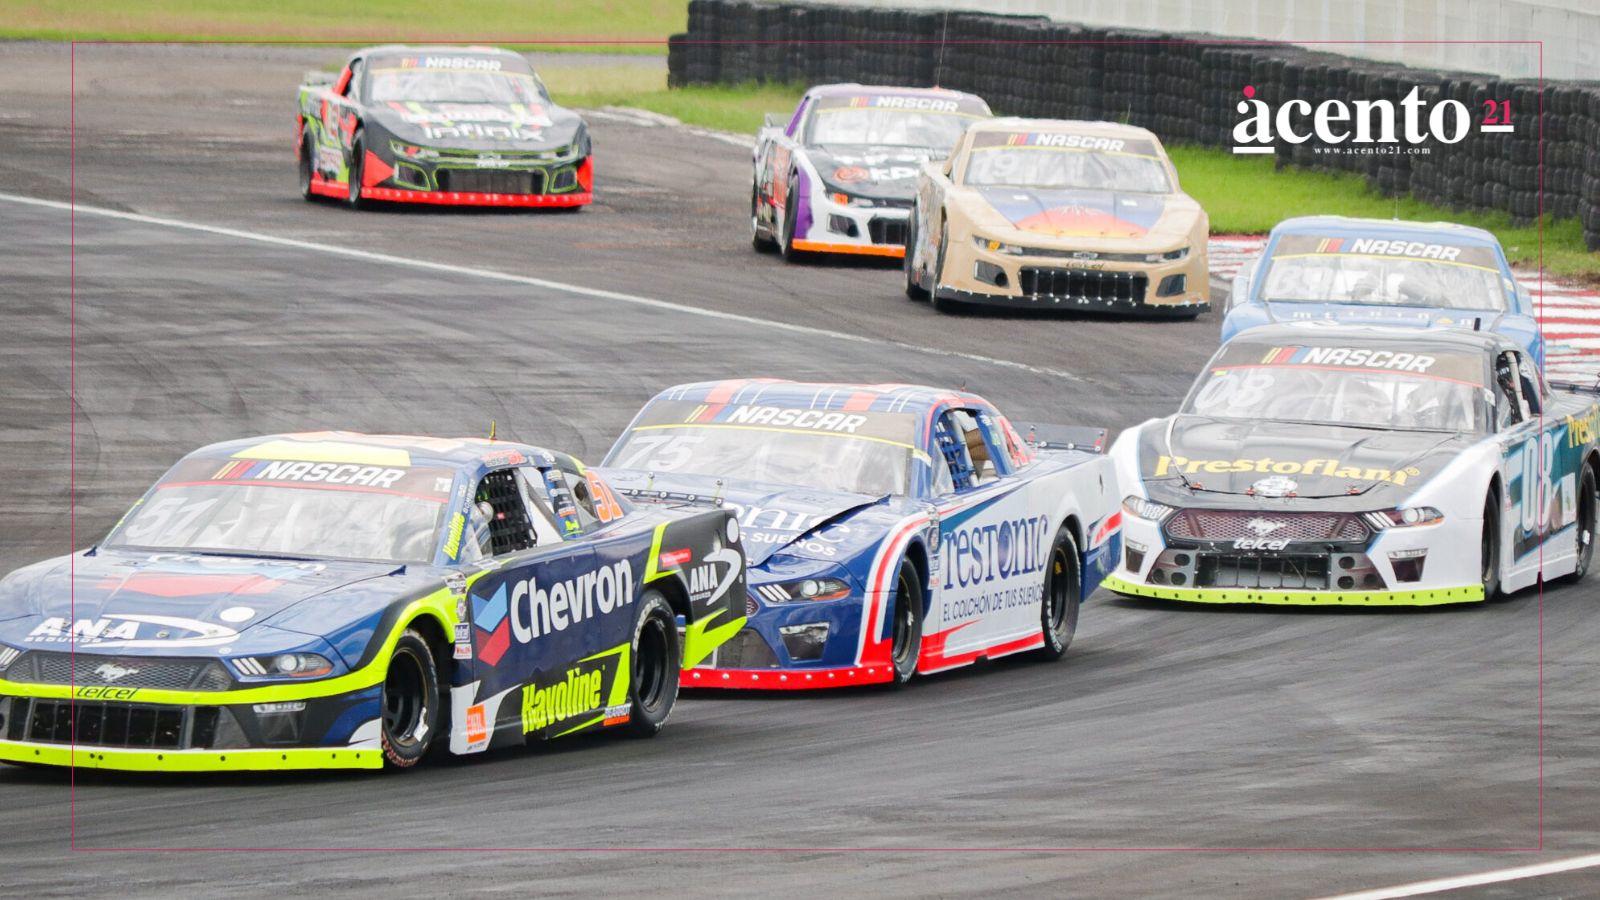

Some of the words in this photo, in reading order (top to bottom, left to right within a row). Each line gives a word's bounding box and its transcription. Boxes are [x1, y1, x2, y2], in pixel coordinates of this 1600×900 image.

[426, 57, 501, 71] NASCAR
[876, 96, 959, 112] NASCAR
[1036, 133, 1125, 151] NASCAR
[1351, 238, 1461, 261] NASCAR
[1301, 346, 1436, 372] NASCAR
[725, 405, 867, 433] NASCAR
[621, 435, 704, 471] 75
[254, 461, 405, 489] NASCAR
[1521, 429, 1553, 537] 08
[125, 497, 218, 538] 51
[1233, 537, 1290, 551] telcel
[690, 563, 718, 593] ANA
[510, 559, 633, 644] Chevron
[943, 603, 951, 621] EL
[953, 590, 990, 619] COLCHÓN
[993, 592, 1003, 611] DE
[1005, 588, 1017, 608] TUS
[28, 617, 140, 639] ANA
[76, 685, 139, 700] telcel
[521, 666, 602, 736] Havoline
